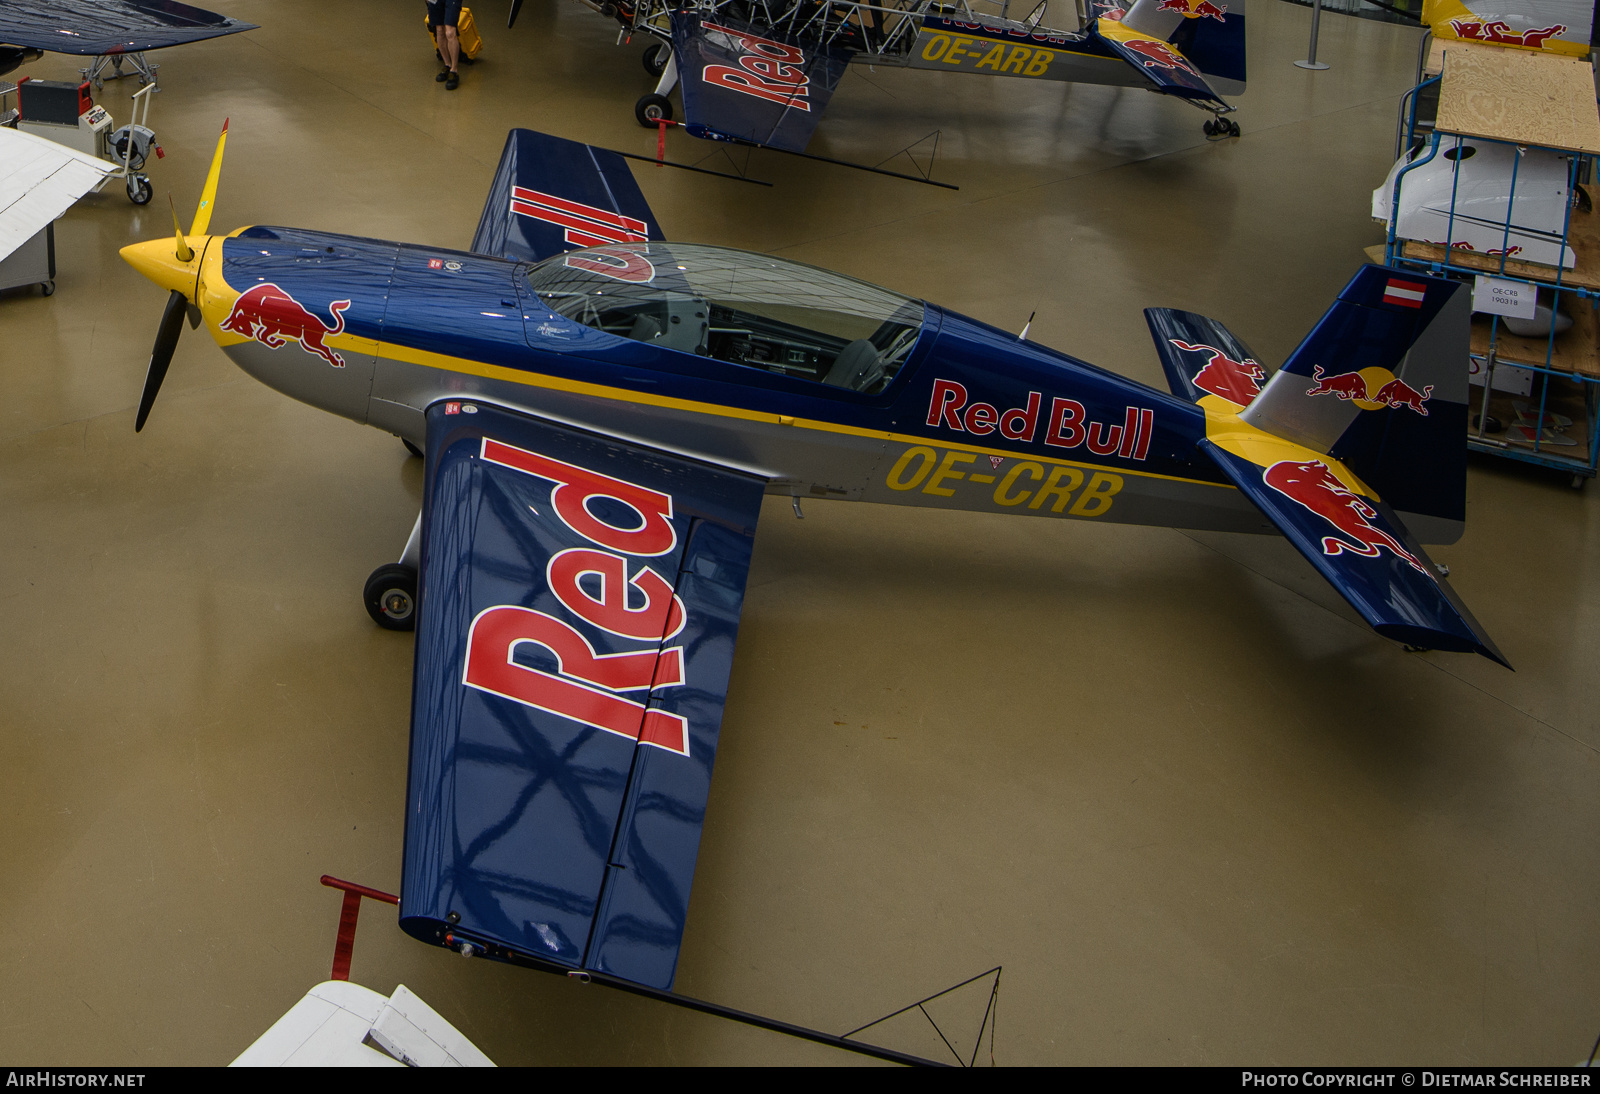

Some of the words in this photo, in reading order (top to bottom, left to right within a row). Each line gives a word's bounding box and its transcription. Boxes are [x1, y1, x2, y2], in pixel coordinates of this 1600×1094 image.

[700, 20, 811, 112] Red
[921, 34, 1055, 77] OE-ARB
[510, 185, 656, 283] ull
[1491, 296, 1518, 306] 190318
[1492, 287, 1518, 297] OE-CRB
[926, 378, 1042, 443] Red
[1044, 396, 1154, 461] Bull
[885, 445, 1124, 518] OE-CRB
[462, 436, 691, 757] Red
